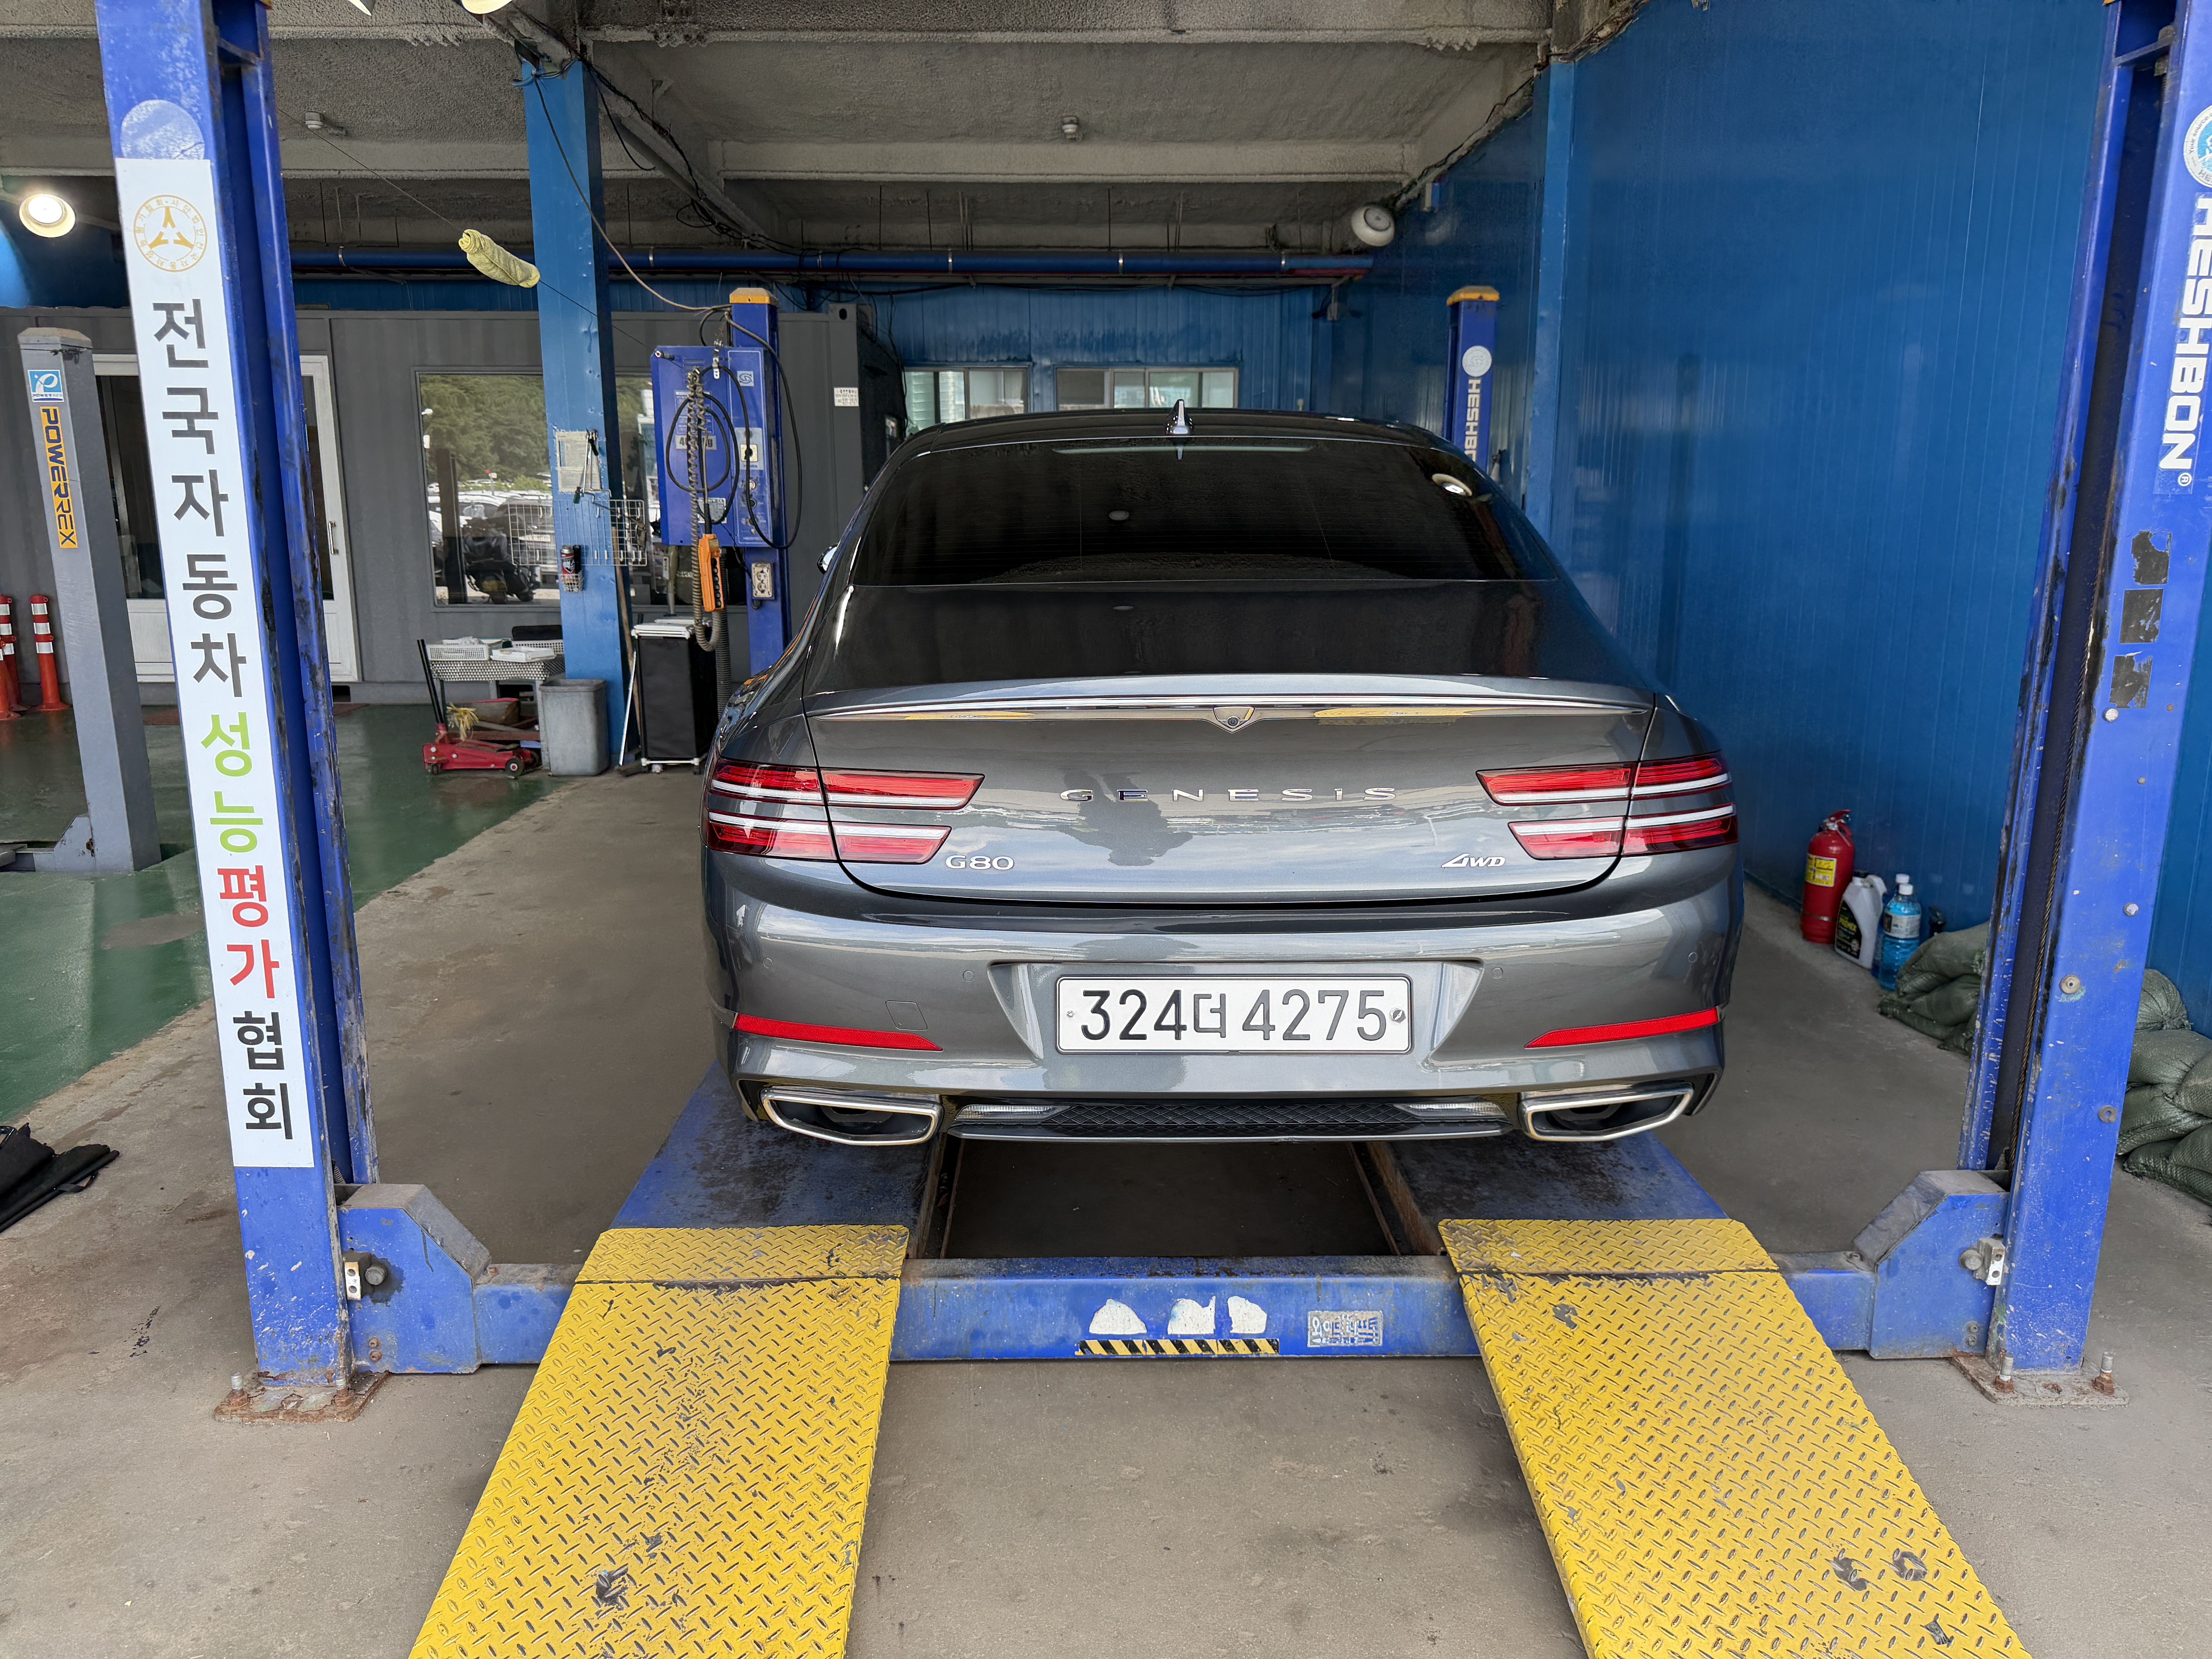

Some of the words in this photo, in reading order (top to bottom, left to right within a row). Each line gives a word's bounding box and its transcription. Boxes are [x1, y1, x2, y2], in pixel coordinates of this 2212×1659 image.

[42, 409, 76, 545] POWERREX
[1060, 787, 1396, 802] GENESIS
[945, 855, 1014, 870] G80
[1081, 989, 1226, 1041] 324더
[1242, 989, 1387, 1041] 4275
